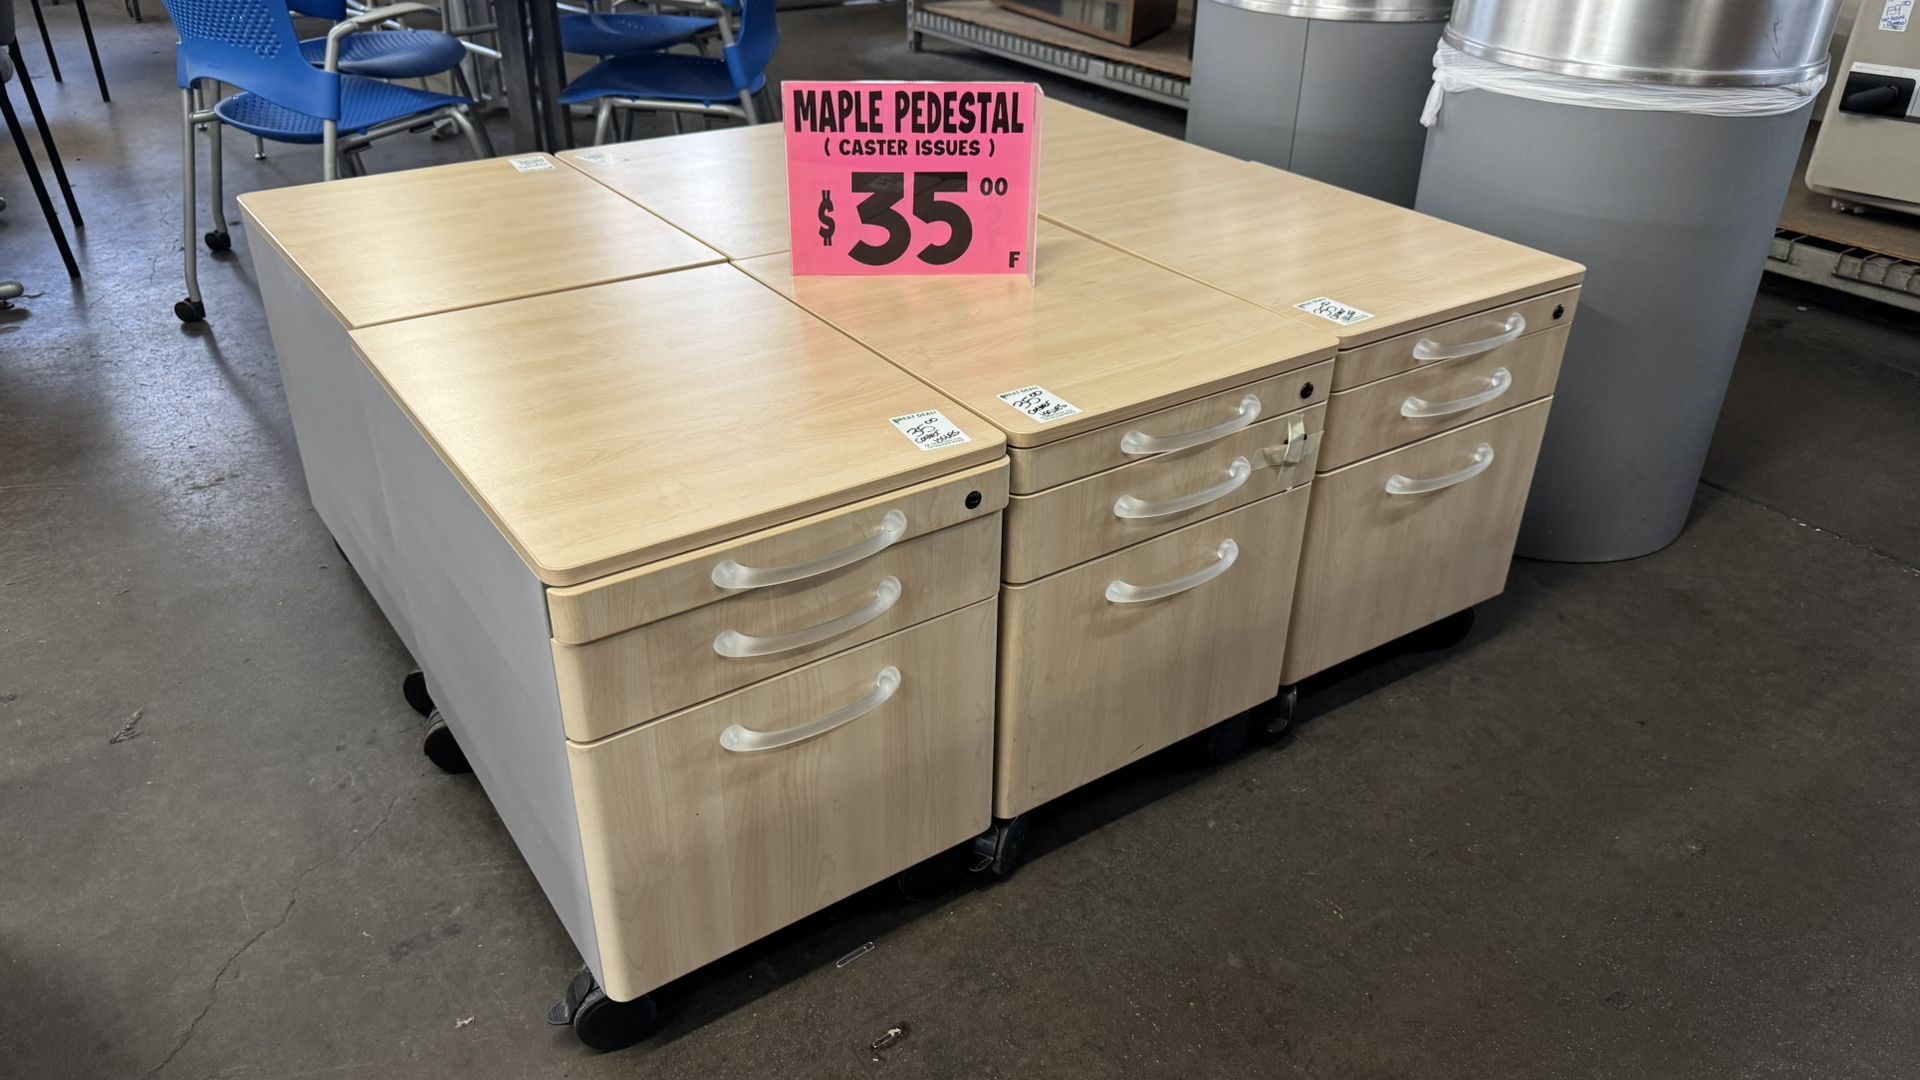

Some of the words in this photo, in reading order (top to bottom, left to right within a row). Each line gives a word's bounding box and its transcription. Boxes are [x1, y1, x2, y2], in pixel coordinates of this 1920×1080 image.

[794, 90, 883, 133] MAPLE
[895, 91, 1024, 134] PEDESTAL
[839, 139, 907, 155] CASTER
[916, 140, 980, 156] ISSUES
[848, 172, 972, 266] 35
[980, 178, 1008, 196] 00
[1009, 252, 1020, 268] F
